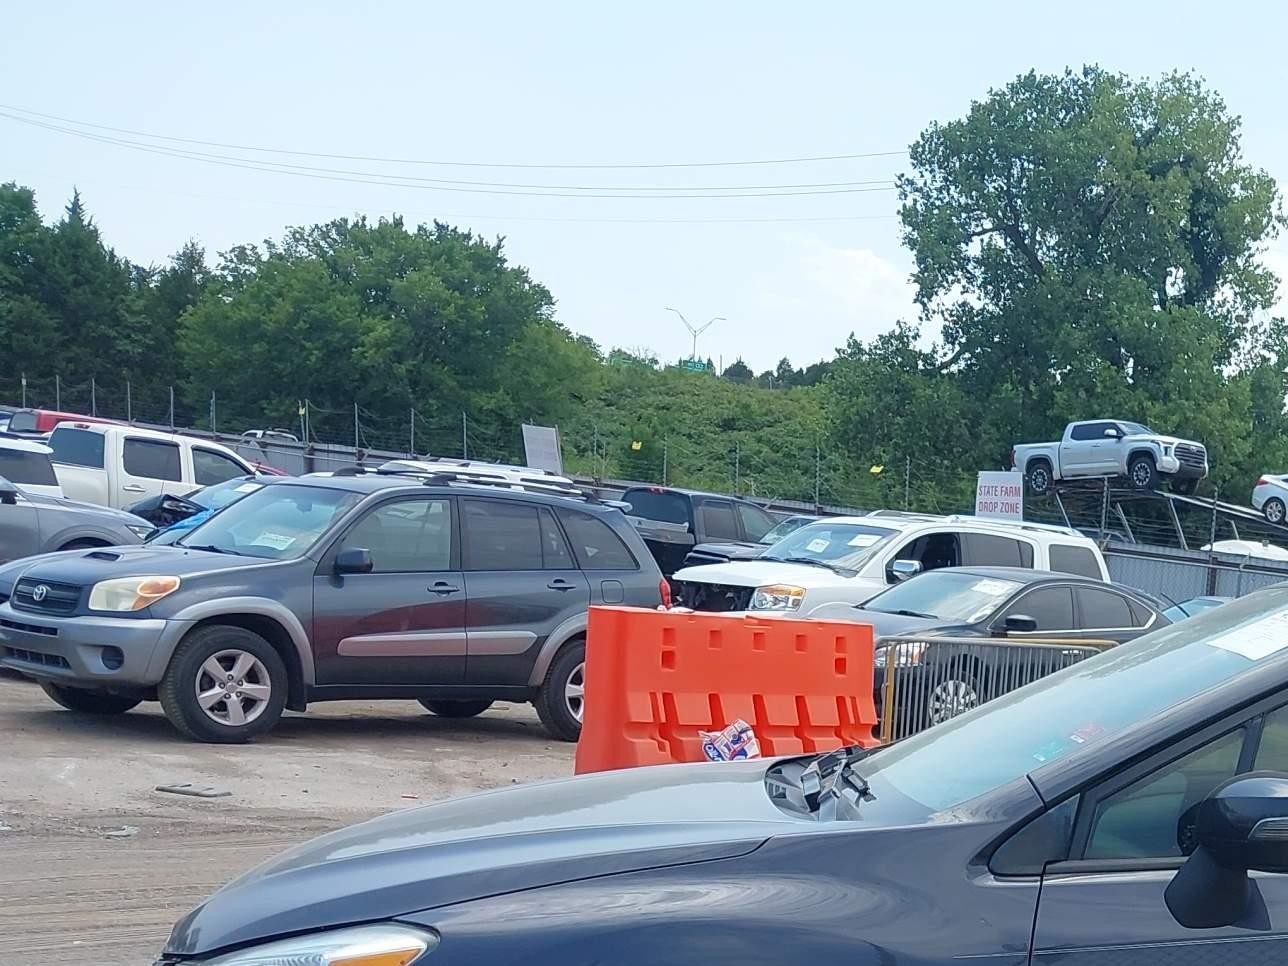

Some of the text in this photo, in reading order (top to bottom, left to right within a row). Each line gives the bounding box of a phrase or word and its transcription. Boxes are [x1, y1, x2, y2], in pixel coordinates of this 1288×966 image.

[978, 485, 1021, 497] STATE FARM
[978, 501, 1020, 514] DROP ZONE
